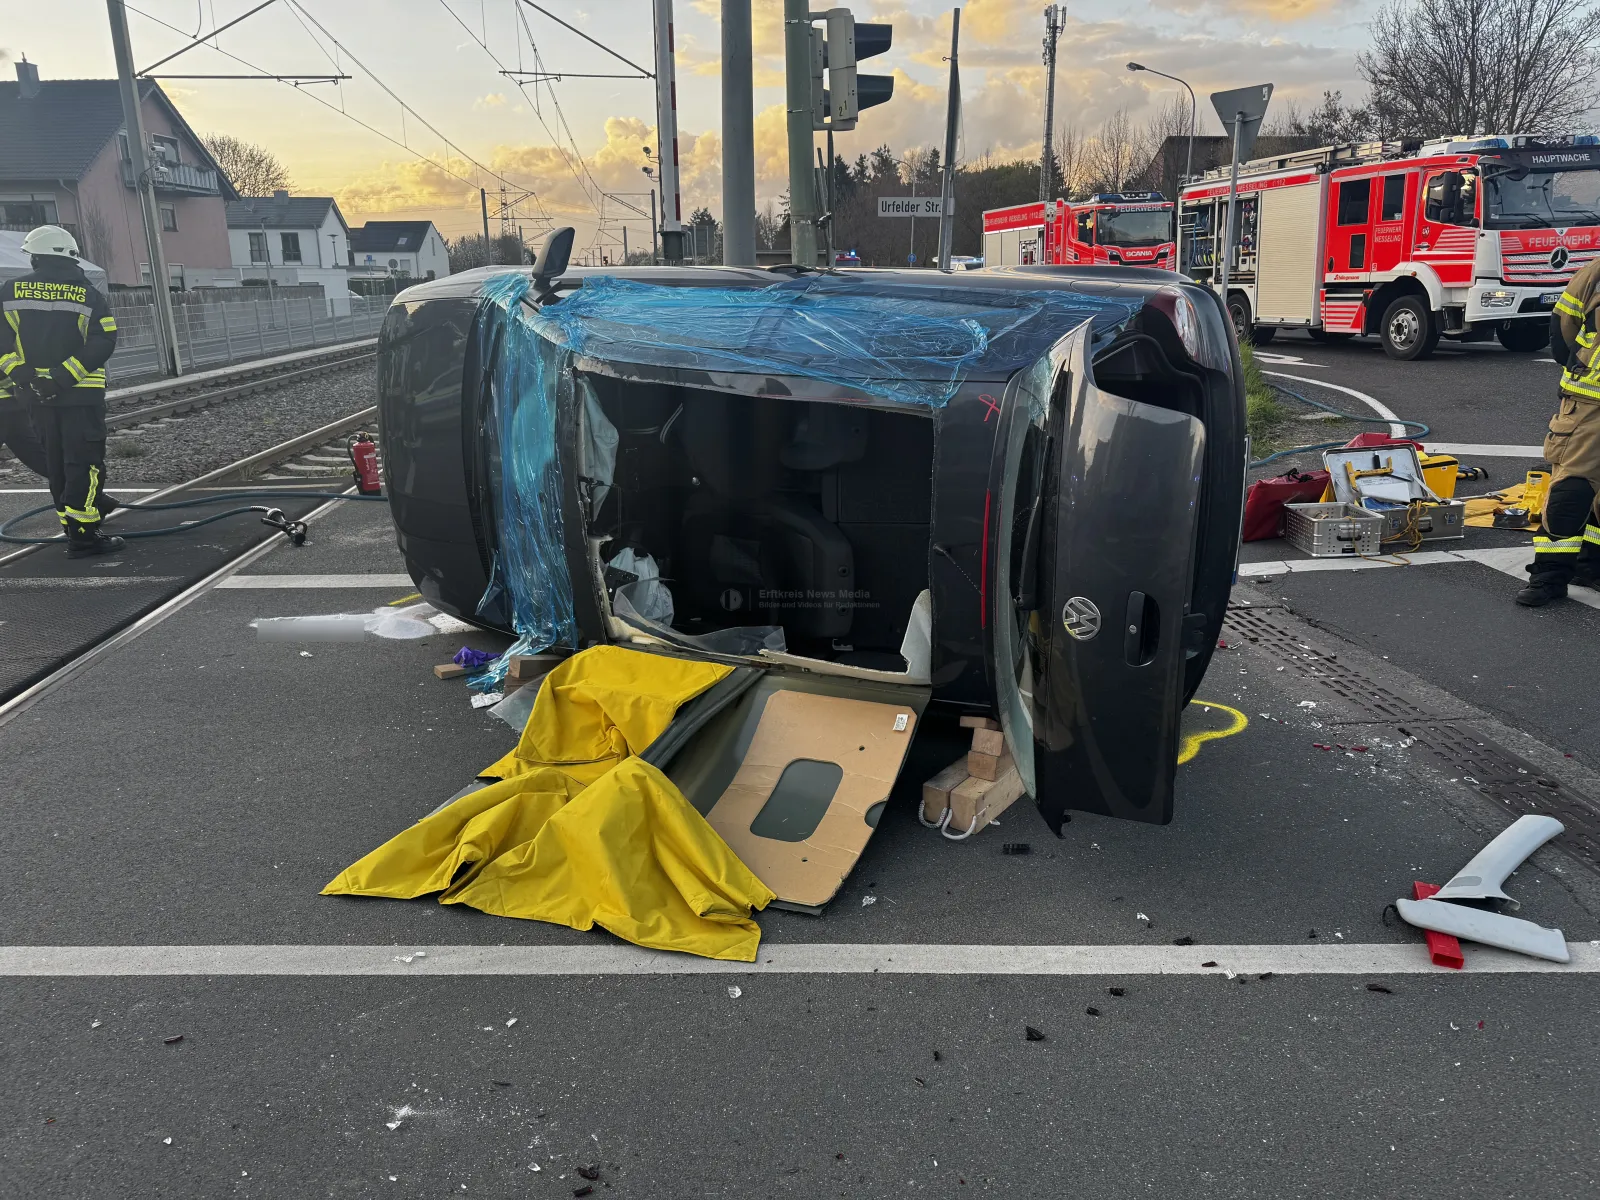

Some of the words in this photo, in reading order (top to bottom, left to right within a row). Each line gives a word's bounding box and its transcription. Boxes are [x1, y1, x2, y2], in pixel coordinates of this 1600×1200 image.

[1532, 153, 1591, 164] HAUPTWACHE
[1207, 187, 1230, 197] FEUERWE
[1237, 181, 1268, 192] WESSELING
[881, 200, 921, 213] Urfelder
[925, 200, 942, 213] Str.
[1115, 203, 1163, 213] FEUERWEHR
[1375, 226, 1402, 234] FEUERWEHR
[1374, 234, 1402, 243] WESSELING
[1528, 234, 1592, 248] FEUERWEHR
[14, 281, 87, 296] FEUERWEHR
[14, 289, 86, 303] WESSELING
